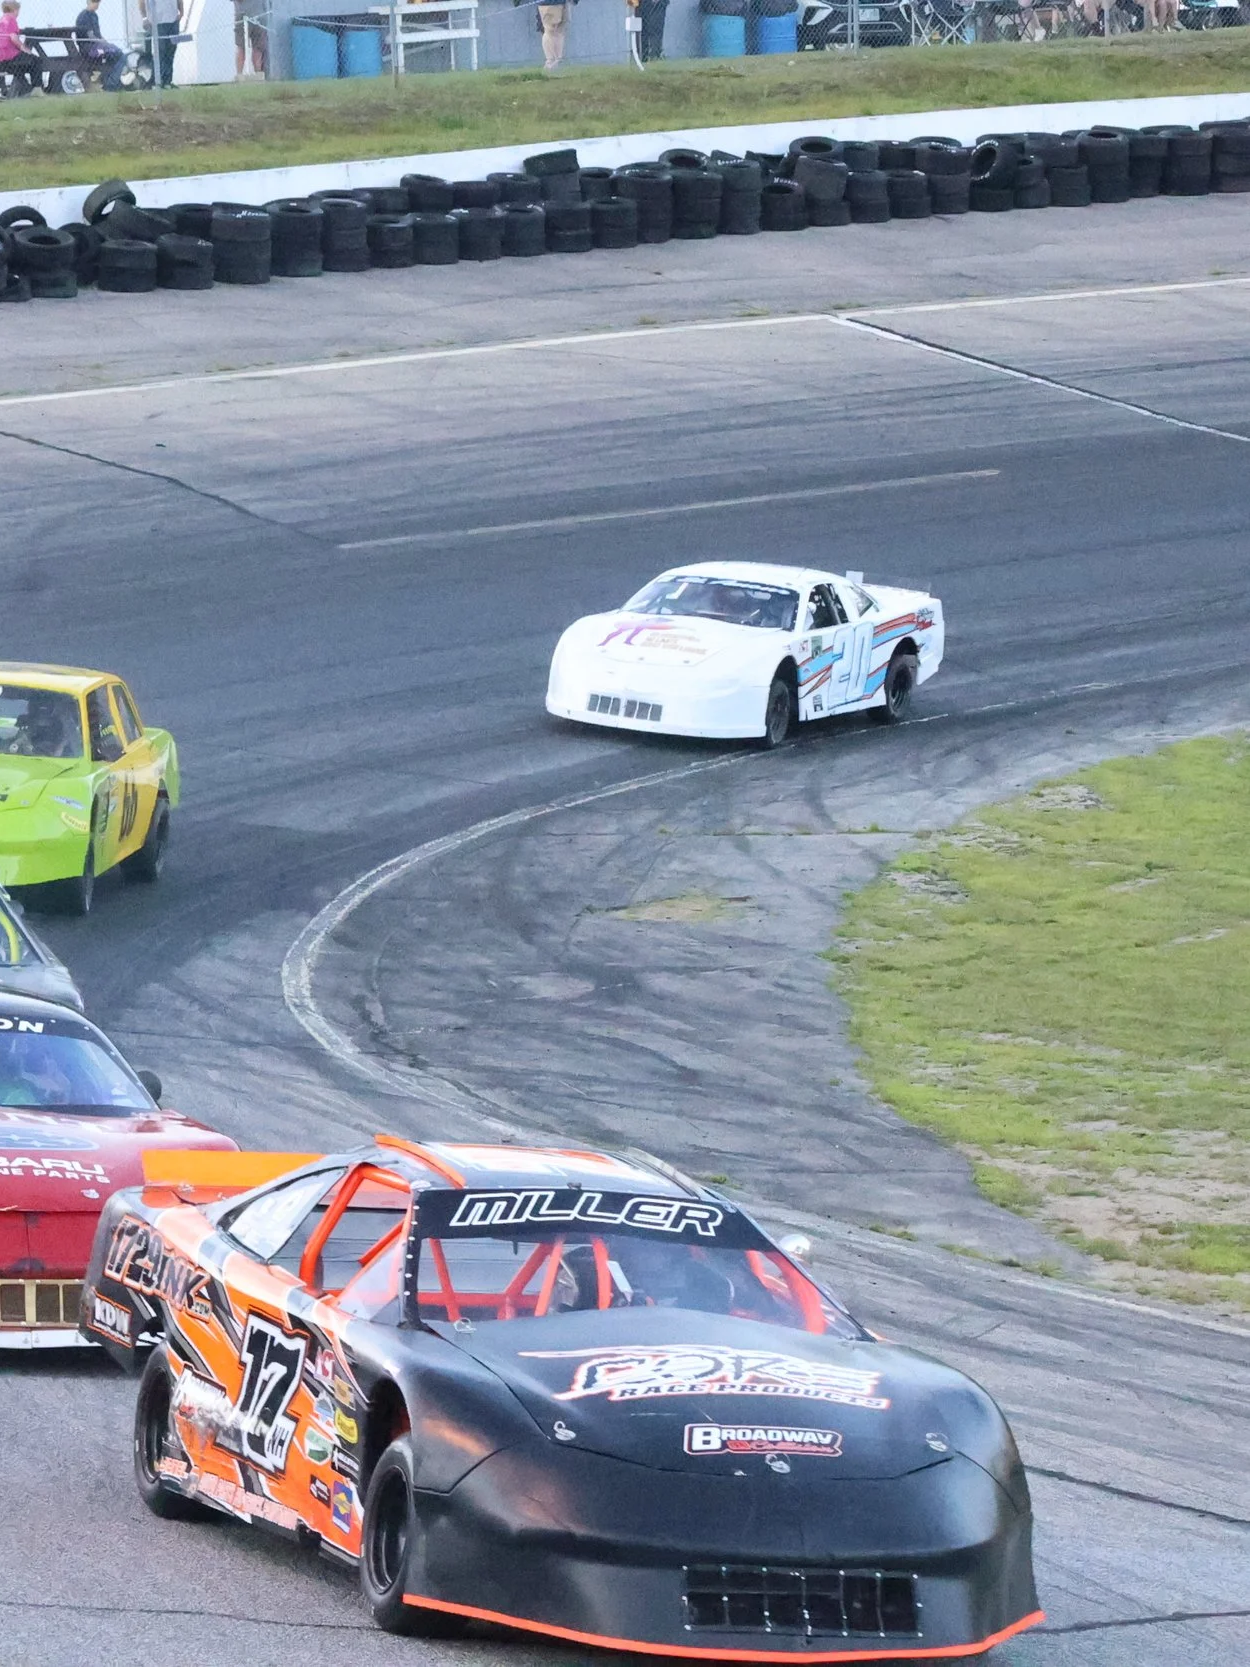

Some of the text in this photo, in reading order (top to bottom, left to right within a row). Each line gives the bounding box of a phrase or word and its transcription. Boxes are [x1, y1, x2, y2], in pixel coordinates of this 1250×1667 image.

[32, 1169, 111, 1184] PARTS
[449, 1190, 724, 1237] MILLER
[239, 1312, 307, 1474] 17
[618, 1383, 883, 1408] RACE PRODUCTS
[691, 1426, 833, 1451] BROADWAY
